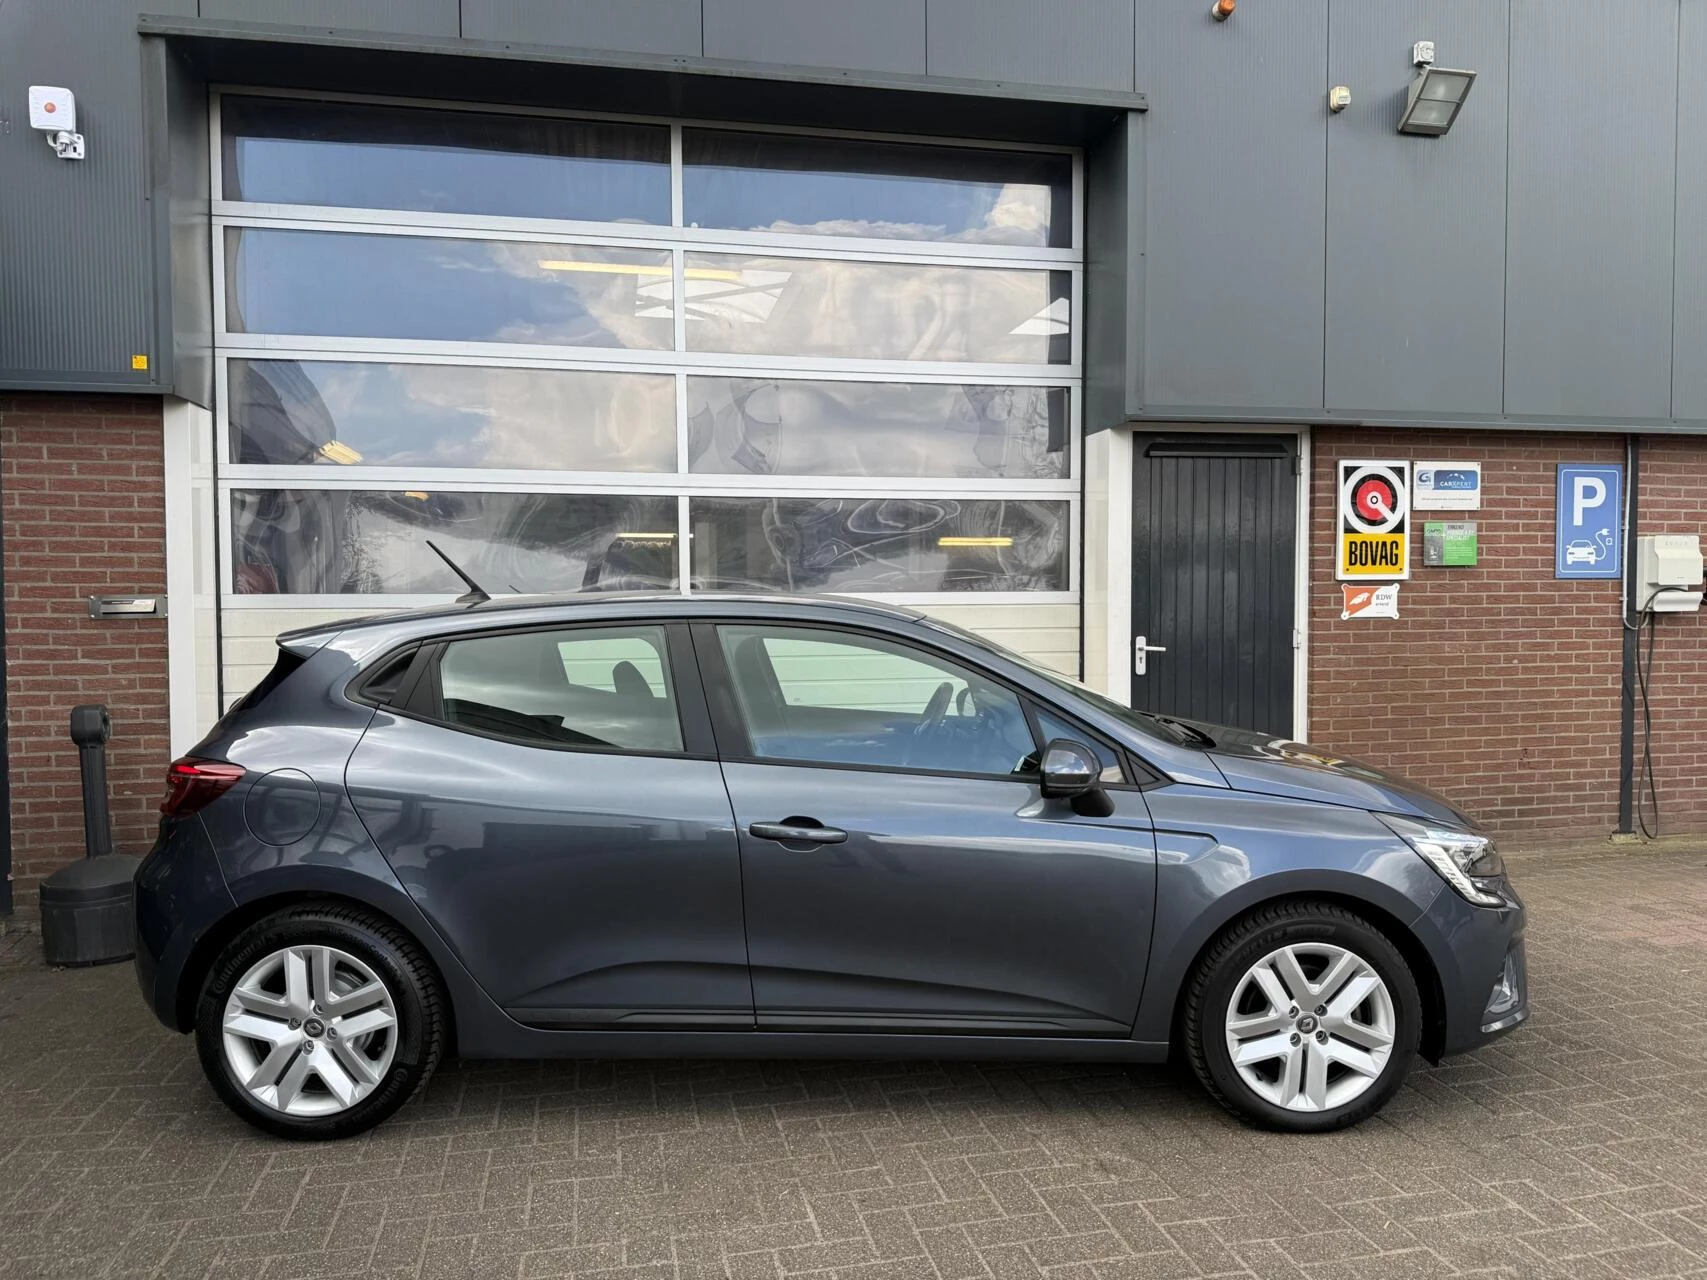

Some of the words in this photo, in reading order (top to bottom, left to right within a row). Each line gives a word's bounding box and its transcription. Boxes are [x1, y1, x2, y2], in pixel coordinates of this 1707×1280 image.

[1573, 476, 1606, 526] P
[1348, 540, 1399, 566] BOVAG
[1375, 593, 1392, 601] RDW
